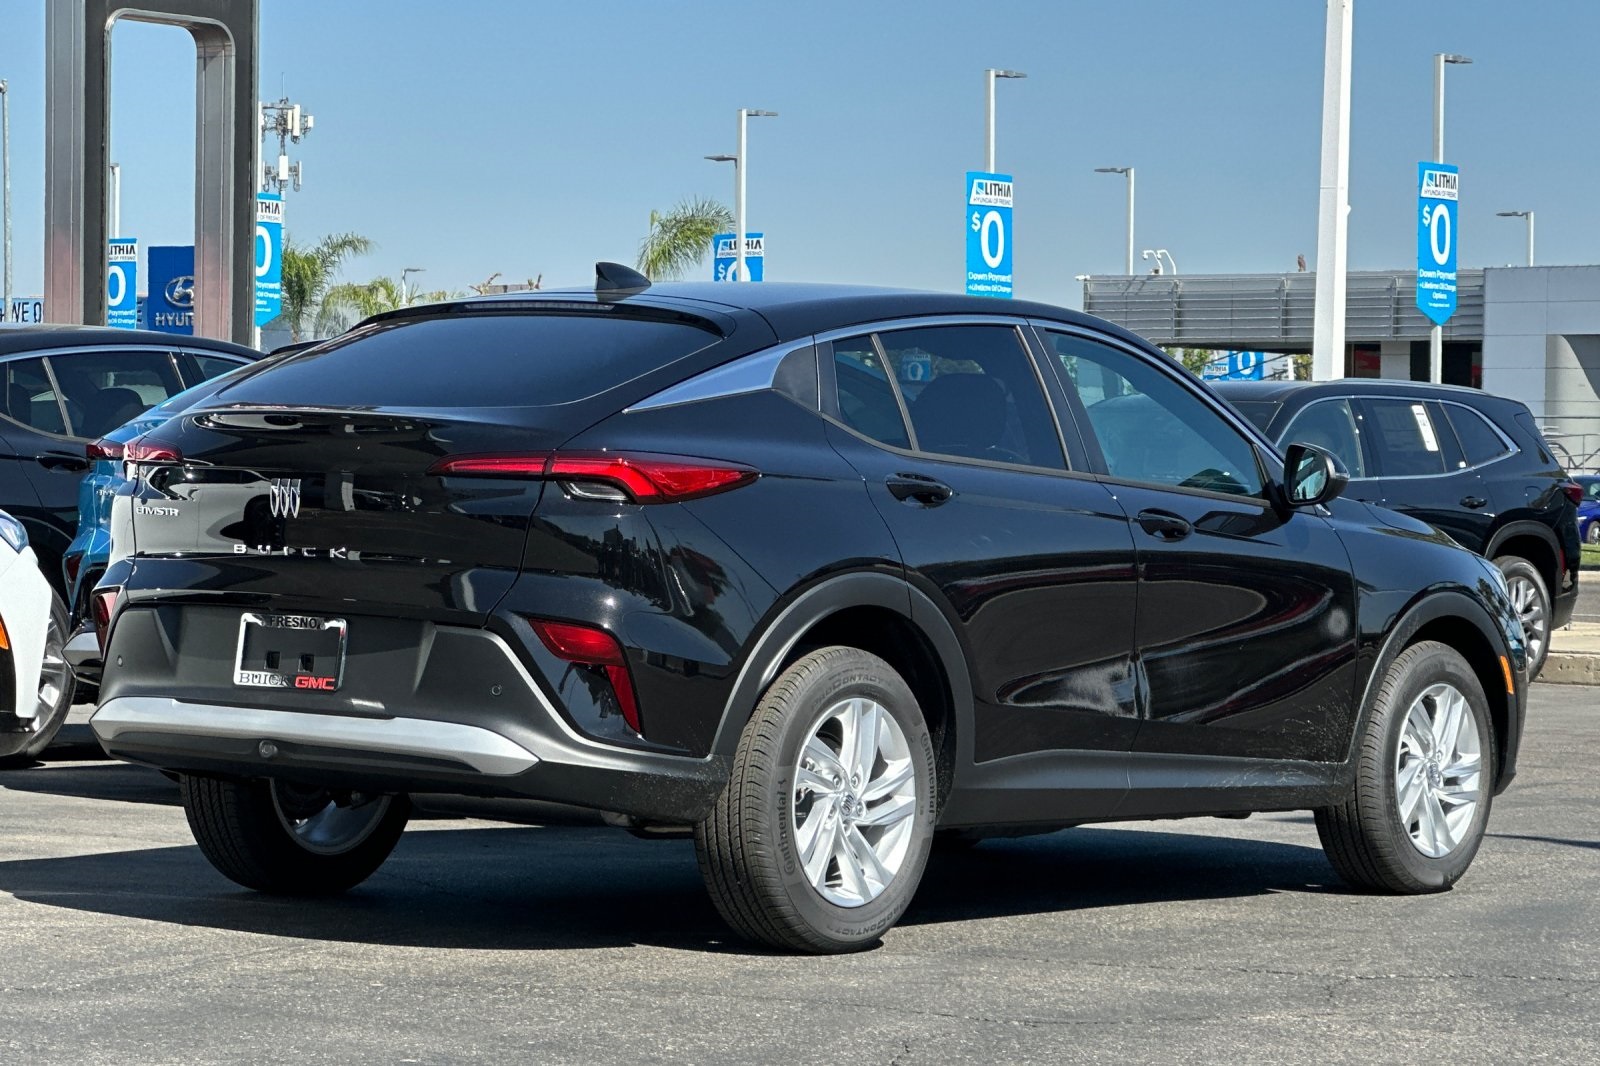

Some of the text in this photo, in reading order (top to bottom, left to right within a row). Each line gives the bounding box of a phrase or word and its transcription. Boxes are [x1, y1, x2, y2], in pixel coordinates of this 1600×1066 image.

[1434, 172, 1457, 190] LITHIA
[985, 182, 1012, 198] LITHIA
[968, 271, 988, 281] Down
[233, 543, 347, 559] BUICK
[269, 616, 318, 629] FRESNO
[239, 672, 336, 691] BUICK GMC
